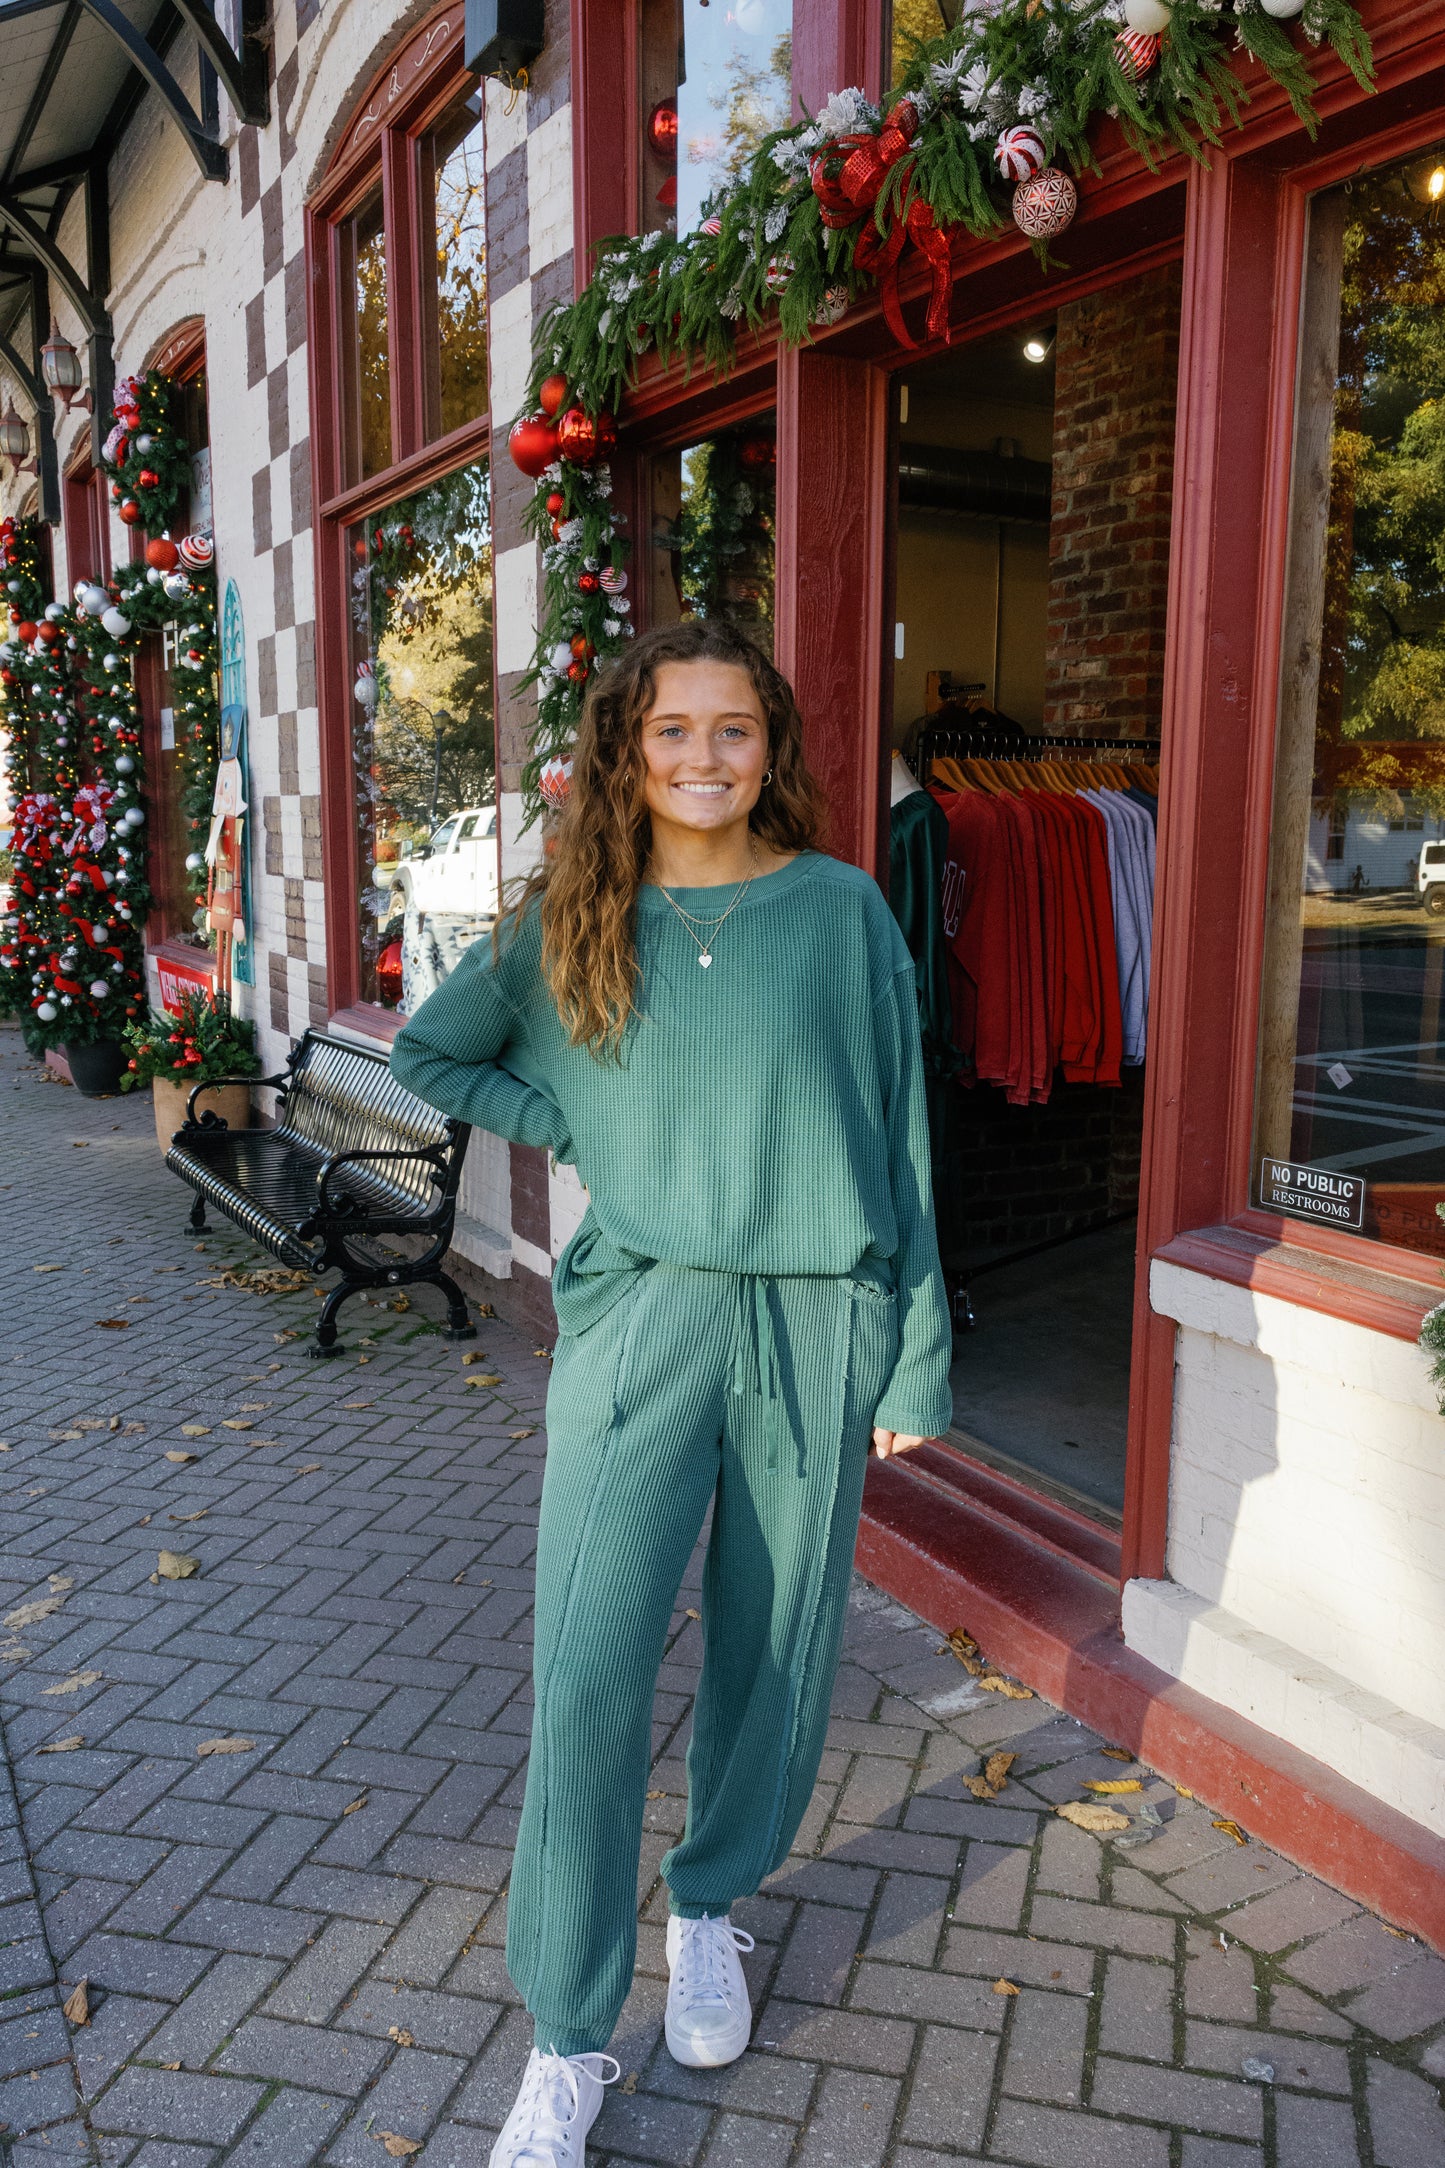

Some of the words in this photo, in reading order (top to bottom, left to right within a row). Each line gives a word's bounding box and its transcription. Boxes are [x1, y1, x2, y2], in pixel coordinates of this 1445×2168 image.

[1271, 1165, 1291, 1184] NO
[1297, 1171, 1354, 1198] PUBLIC
[1272, 1189, 1350, 1219] RESTROOMS
